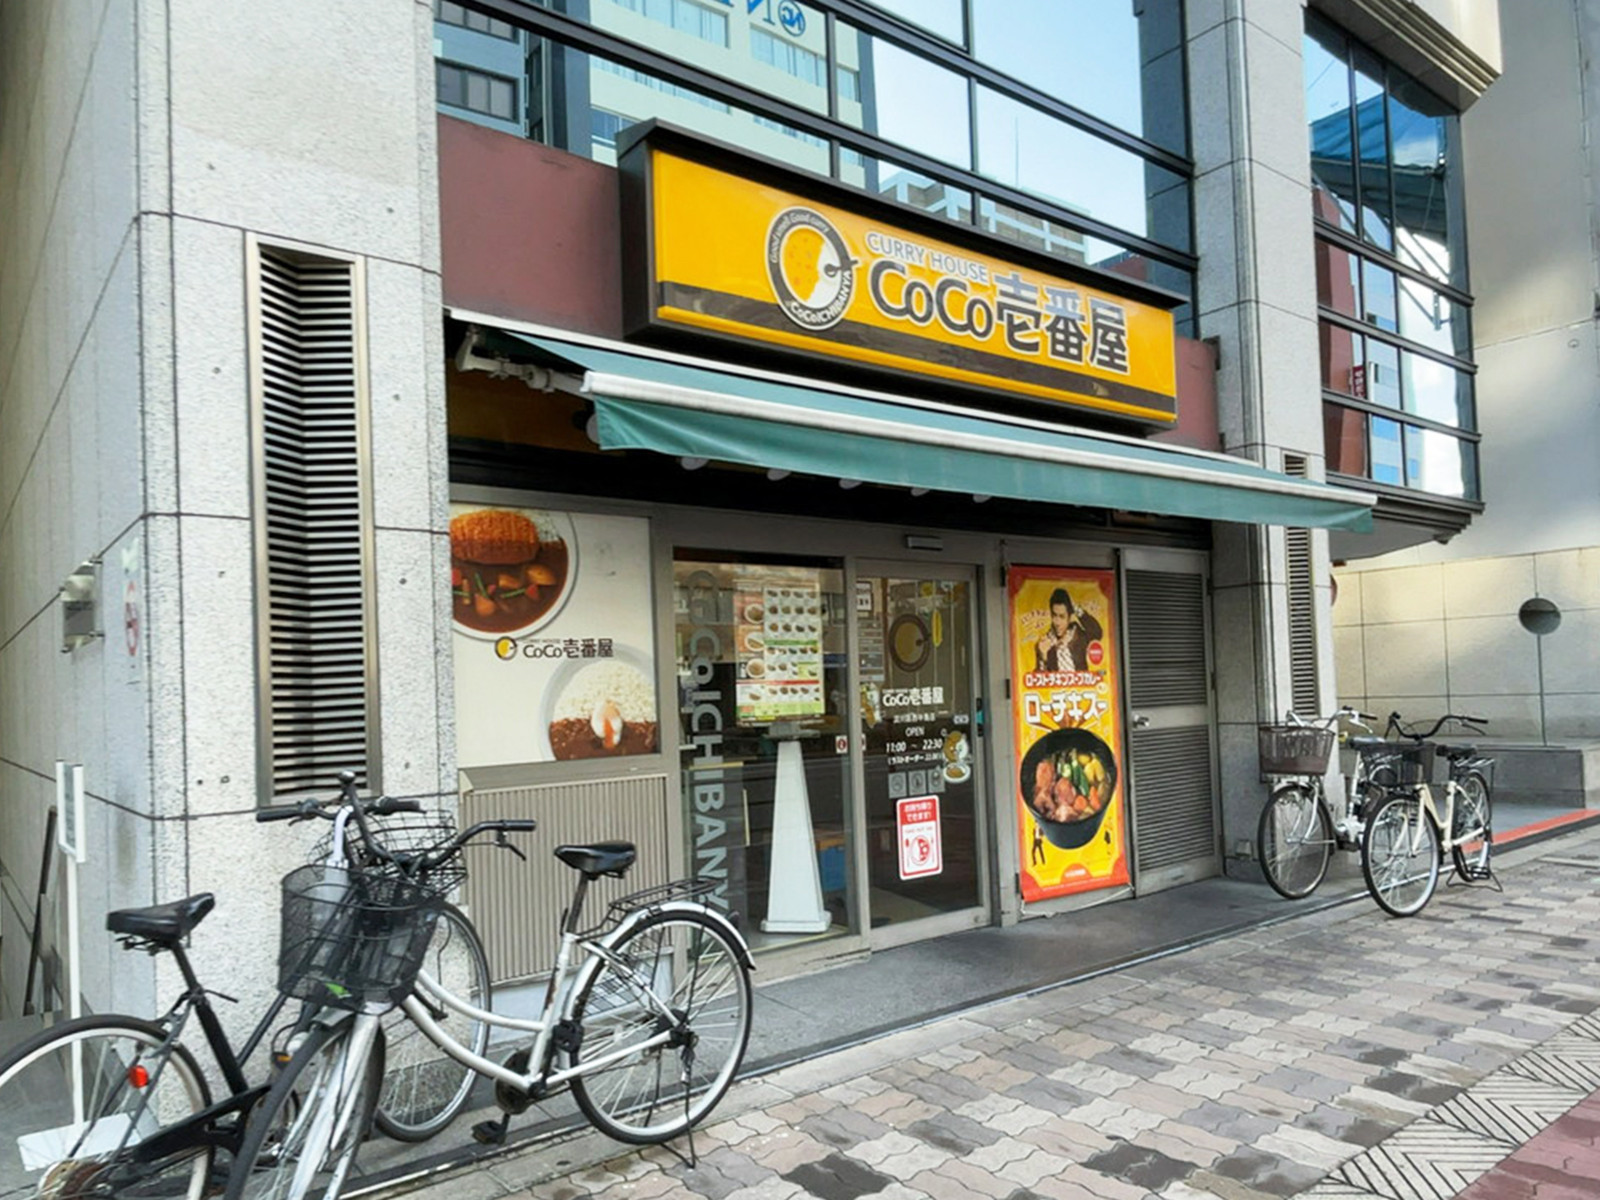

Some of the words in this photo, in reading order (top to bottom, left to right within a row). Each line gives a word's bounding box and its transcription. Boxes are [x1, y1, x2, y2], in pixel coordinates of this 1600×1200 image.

[866, 233, 925, 263] CURRY
[929, 250, 988, 284] HOUSE
[870, 259, 1129, 374] CoCo壱番屋
[523, 638, 614, 659] CoCo壱番屋
[882, 686, 944, 707] CoCo壱番屋
[905, 726, 925, 737] OPEN
